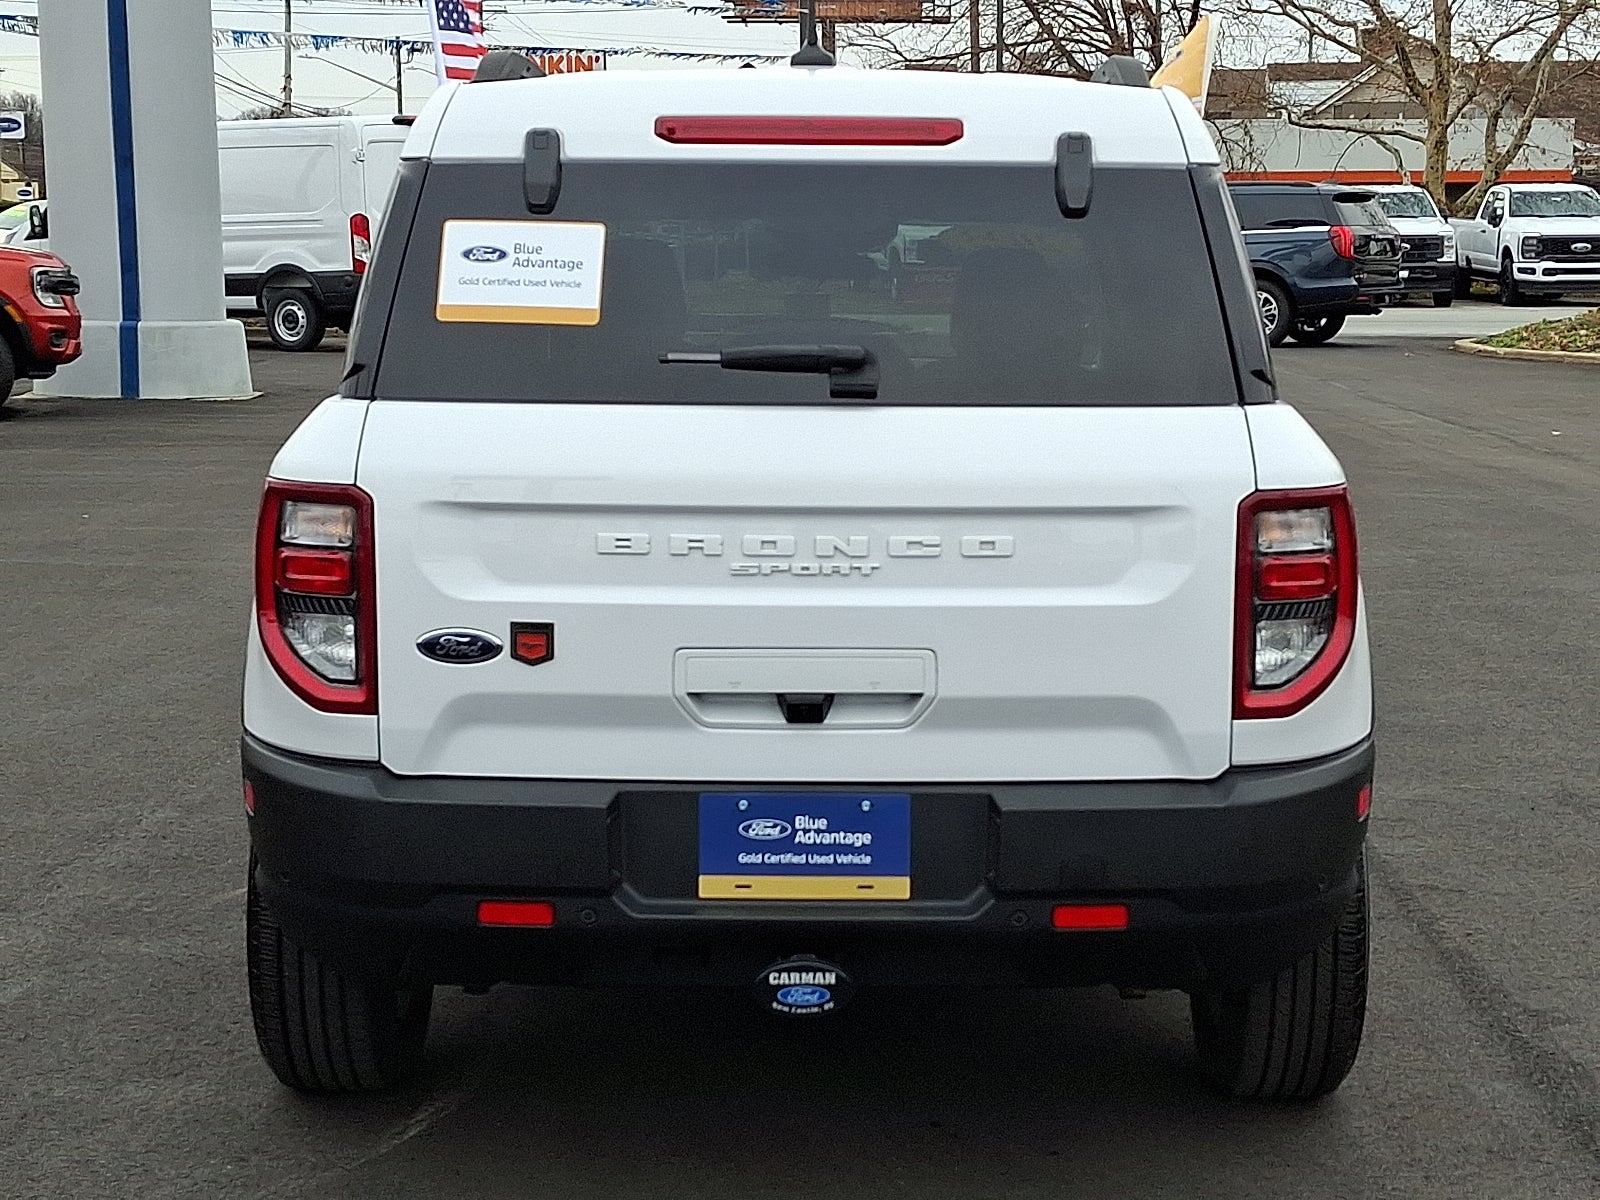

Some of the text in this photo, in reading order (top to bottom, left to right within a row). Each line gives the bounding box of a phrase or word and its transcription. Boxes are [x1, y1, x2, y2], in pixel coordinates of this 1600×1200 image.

[513, 242, 543, 255] Blue
[512, 256, 584, 271] Advantage
[458, 276, 582, 289] Gold Certified Used Vehicle
[596, 531, 1018, 558] BRONCO
[730, 561, 881, 577] SPORT
[435, 635, 483, 656] Ford
[794, 815, 828, 830] Blue
[794, 830, 872, 847] Advantage
[738, 853, 871, 865] Gold Certified Used Vehicle
[769, 972, 836, 985] CARMAN
